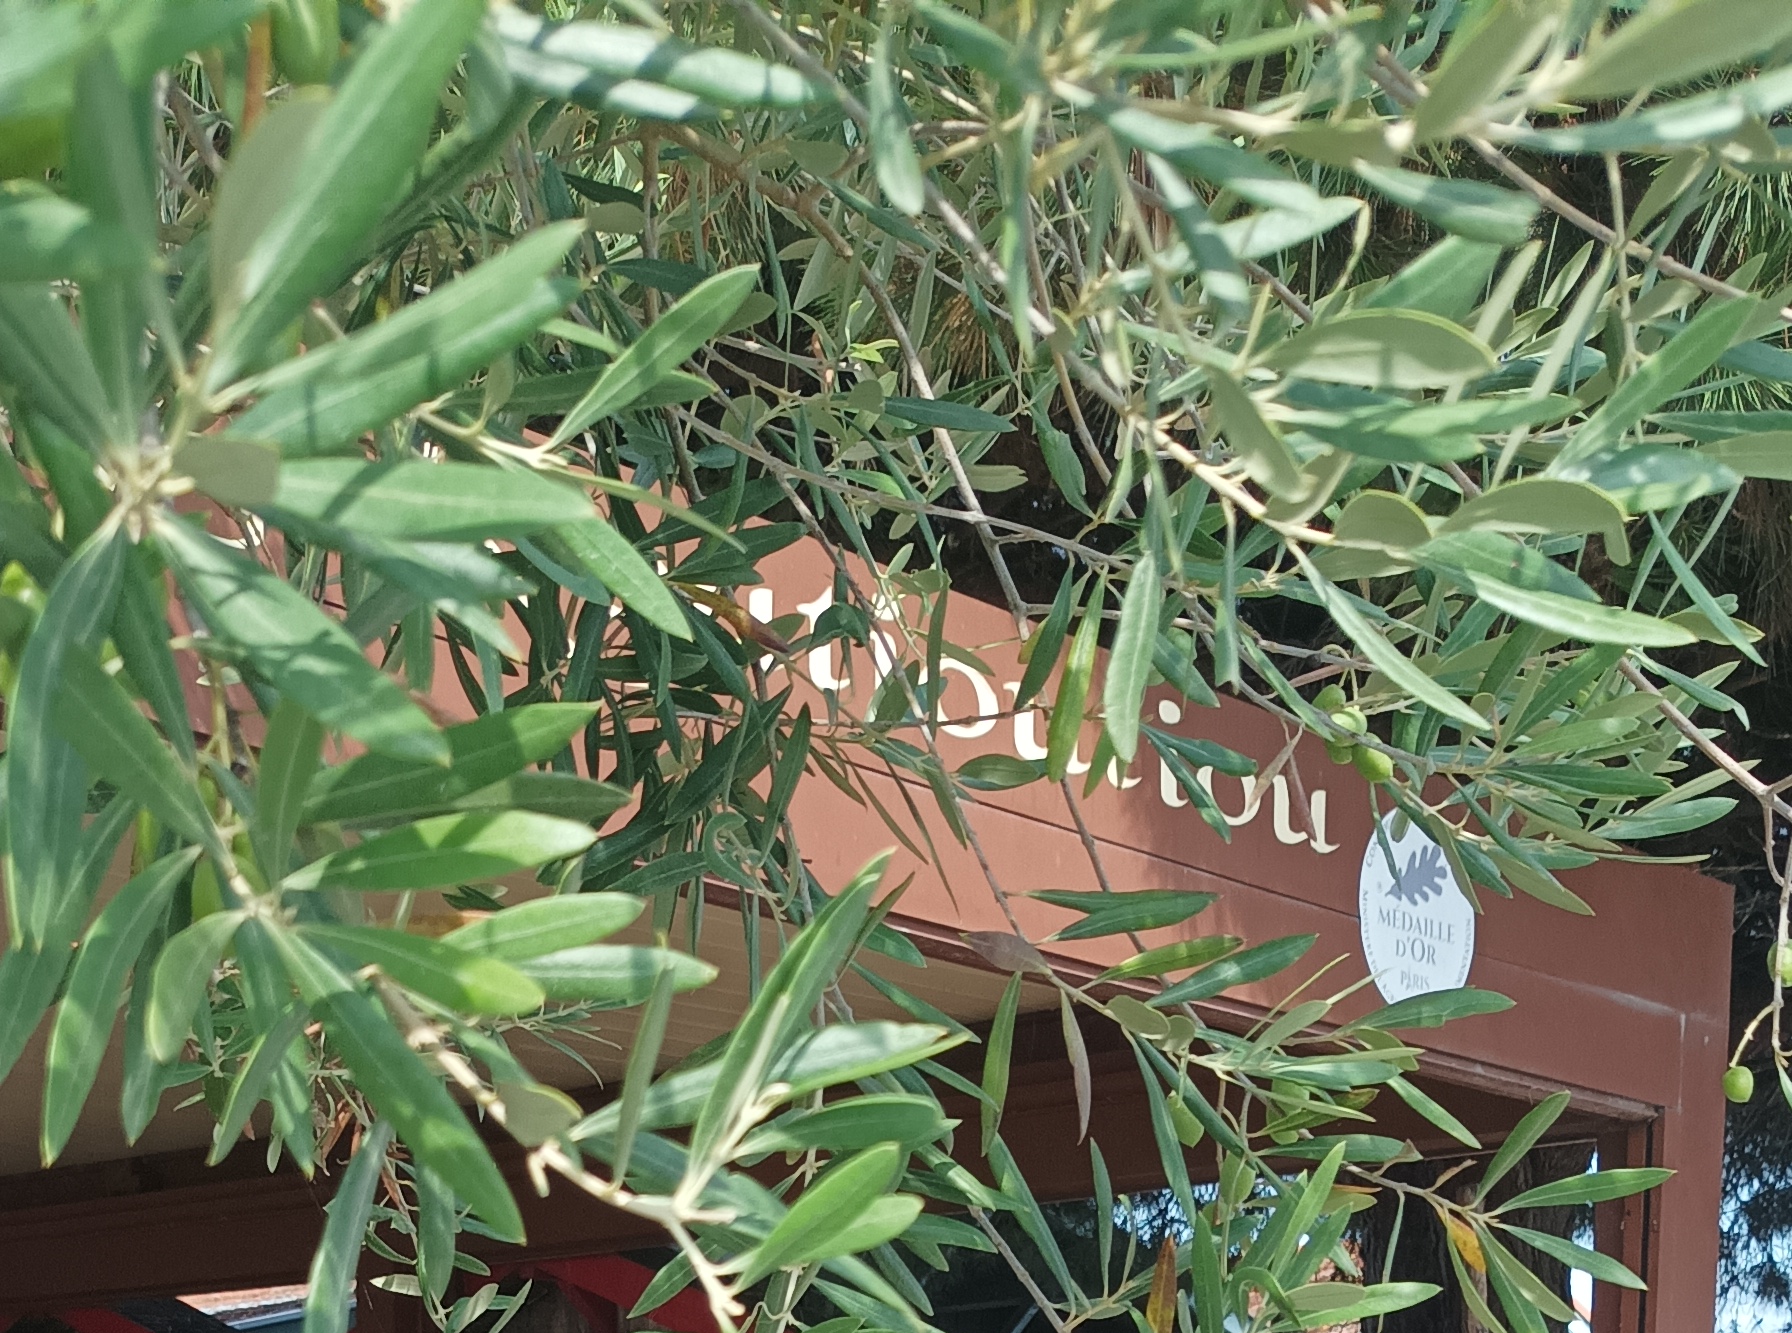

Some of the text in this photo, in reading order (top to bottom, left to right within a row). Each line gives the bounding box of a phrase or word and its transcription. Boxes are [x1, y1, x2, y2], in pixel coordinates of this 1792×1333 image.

[1378, 904, 1455, 944] MÉDAILLE
[1395, 937, 1436, 966] D'OR
[1400, 968, 1430, 991] PARIS
